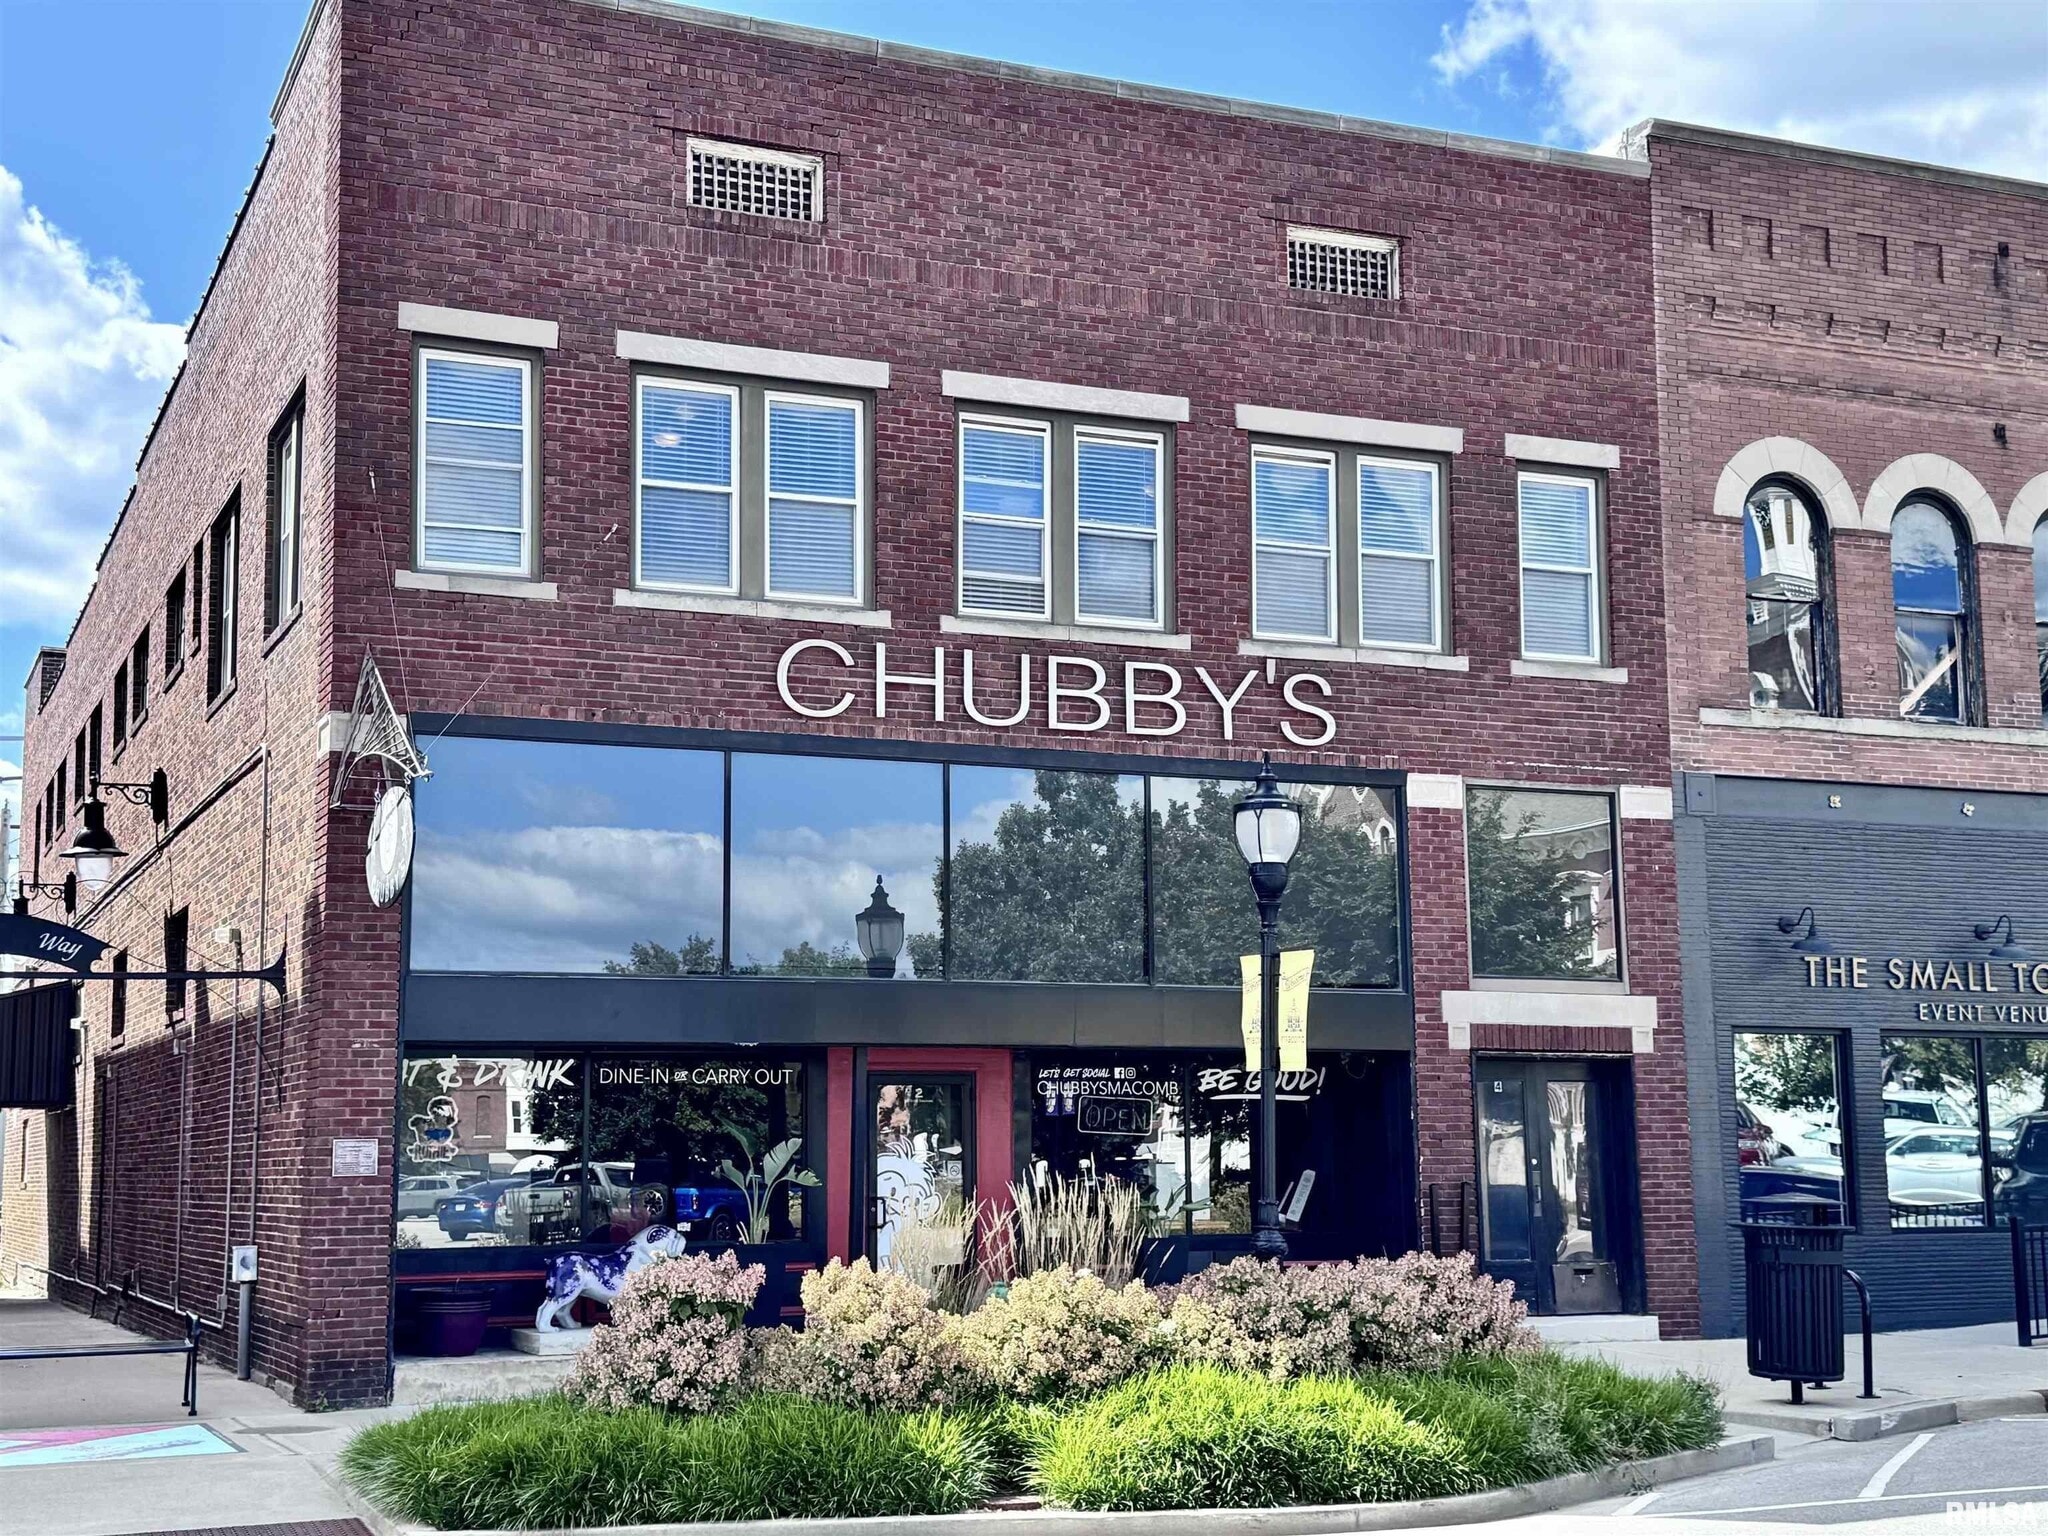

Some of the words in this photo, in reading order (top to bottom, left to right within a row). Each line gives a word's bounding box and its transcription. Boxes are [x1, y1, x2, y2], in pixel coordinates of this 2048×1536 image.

[777, 639, 1336, 746] CHUBBY'S
[39, 933, 83, 962] Way
[1804, 956, 1868, 988] THE
[1888, 958, 1998, 992] SMALL
[1920, 1002, 1984, 1021] EVENT
[473, 1058, 575, 1091] DRINK
[600, 1068, 669, 1084] DINE-IN
[692, 1068, 750, 1085] CARRY
[754, 1069, 793, 1085] OUT
[1039, 1067, 1061, 1079] LET'S
[1063, 1067, 1082, 1078] GET
[1082, 1067, 1111, 1078] SOCIAL
[1197, 1068, 1242, 1093] BE
[914, 1087, 924, 1098] 2
[1037, 1080, 1179, 1096] CHUBBYSMACOMB
[1085, 1104, 1150, 1131] OPEN
